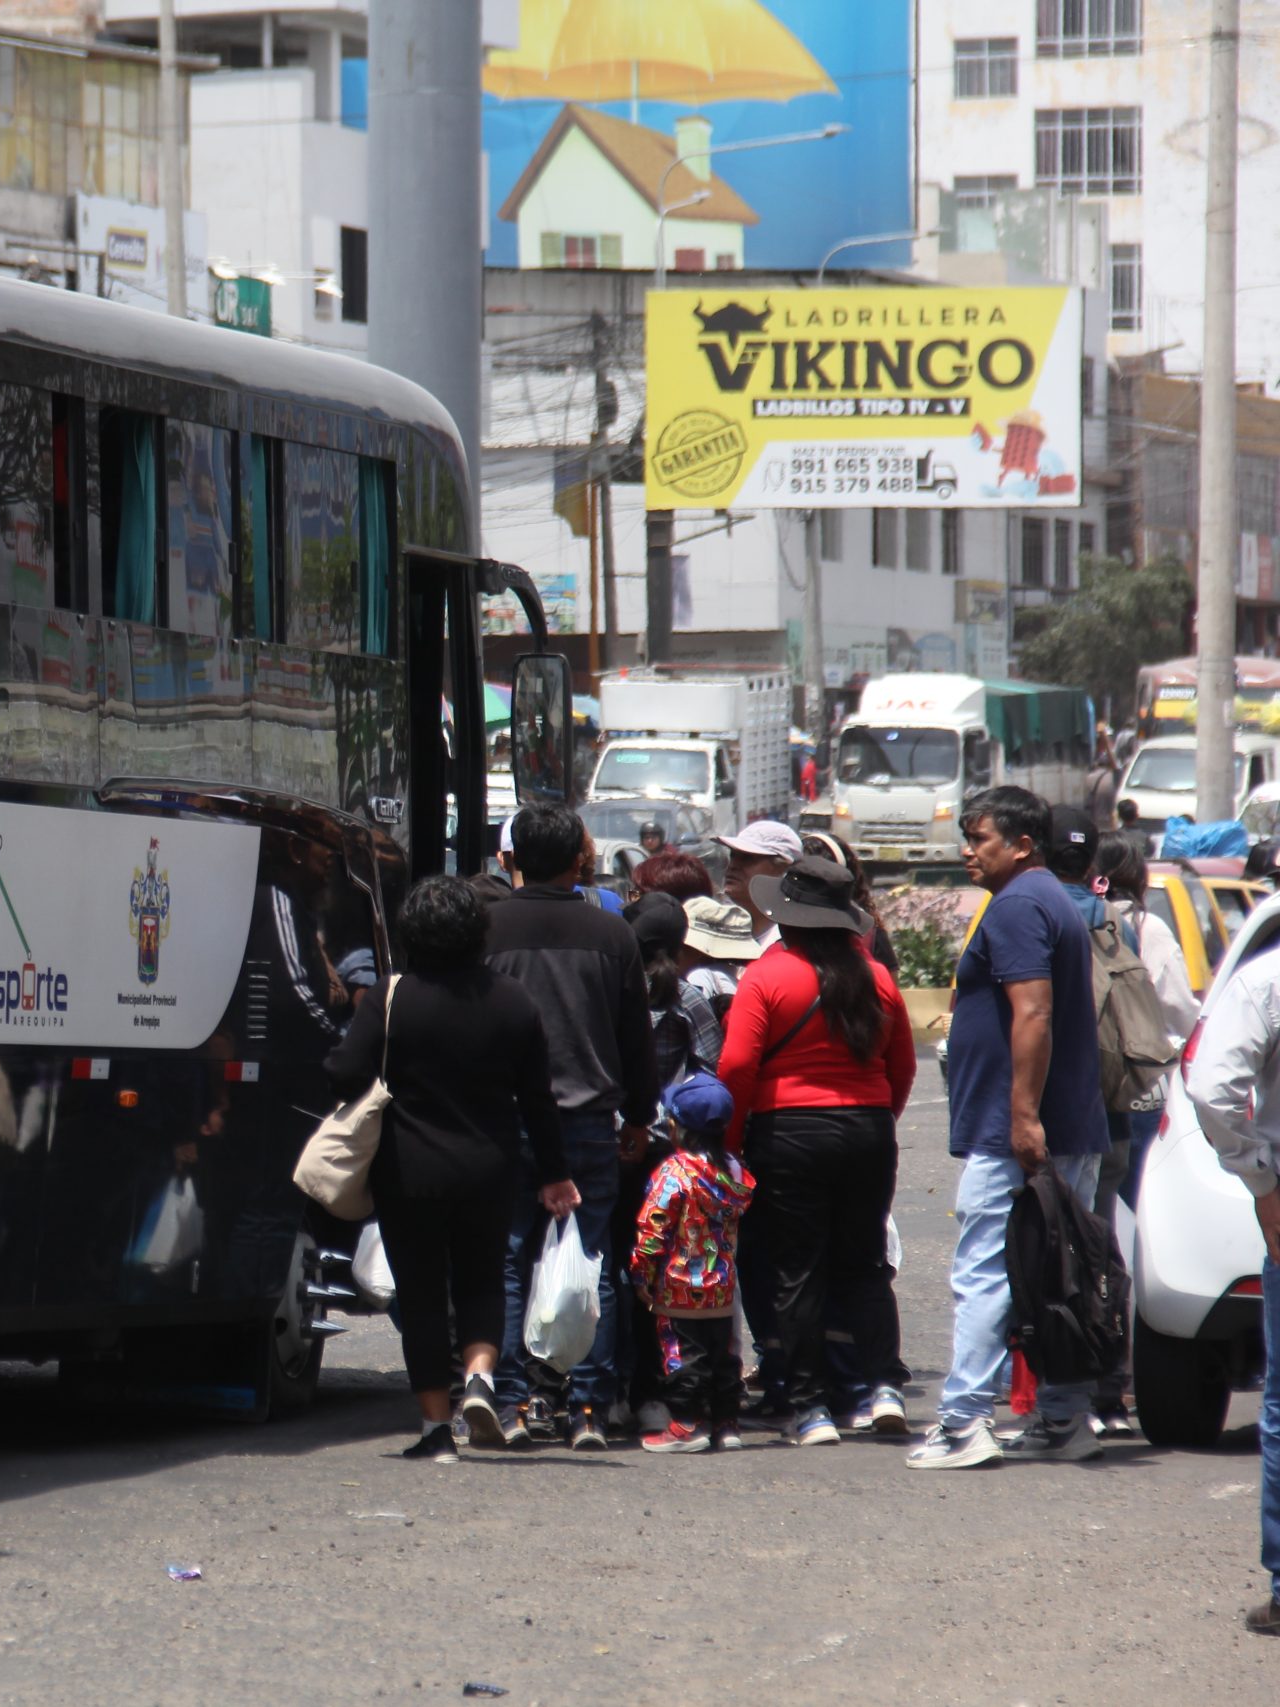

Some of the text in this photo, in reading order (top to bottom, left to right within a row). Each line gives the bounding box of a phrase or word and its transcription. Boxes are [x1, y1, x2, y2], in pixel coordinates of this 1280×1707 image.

[784, 306, 1007, 328] LADRILLERA
[698, 337, 1036, 393] VIKINGO
[756, 399, 855, 416] LADRILLOS
[860, 399, 904, 415] TIPO
[909, 399, 929, 415] IV
[950, 398, 966, 415] V
[791, 457, 913, 474] 991 665 938
[790, 477, 913, 494] 915 379 488
[876, 699, 937, 711] JAC
[117, 992, 177, 1008] Municipalidad Provincial
[13, 1016, 65, 1027] AREQUIPA
[133, 1015, 140, 1027] de
